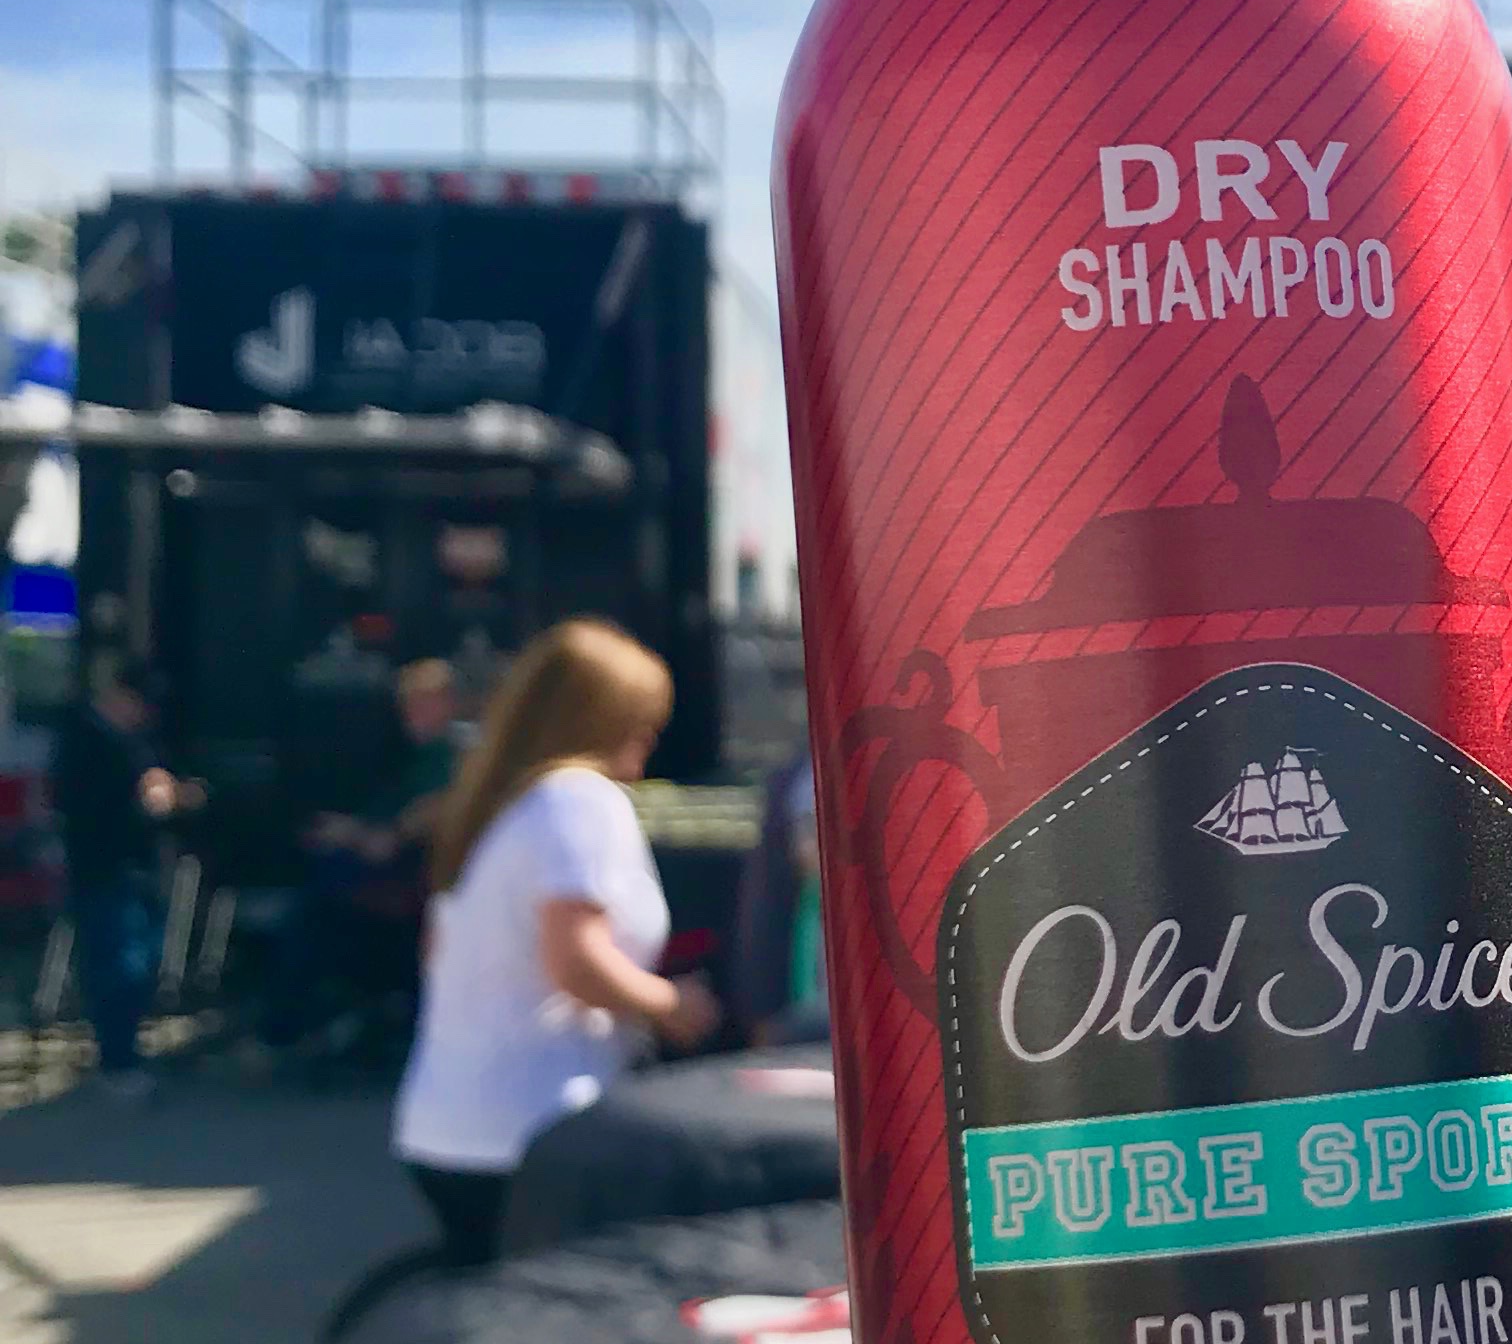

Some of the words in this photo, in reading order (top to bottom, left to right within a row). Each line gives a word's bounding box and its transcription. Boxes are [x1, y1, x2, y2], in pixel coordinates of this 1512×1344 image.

[1099, 139, 1349, 230] DRY
[1058, 236, 1396, 332] SHAMPOO
[1000, 905, 1247, 1063] Old
[989, 1132, 1268, 1239] PURE
